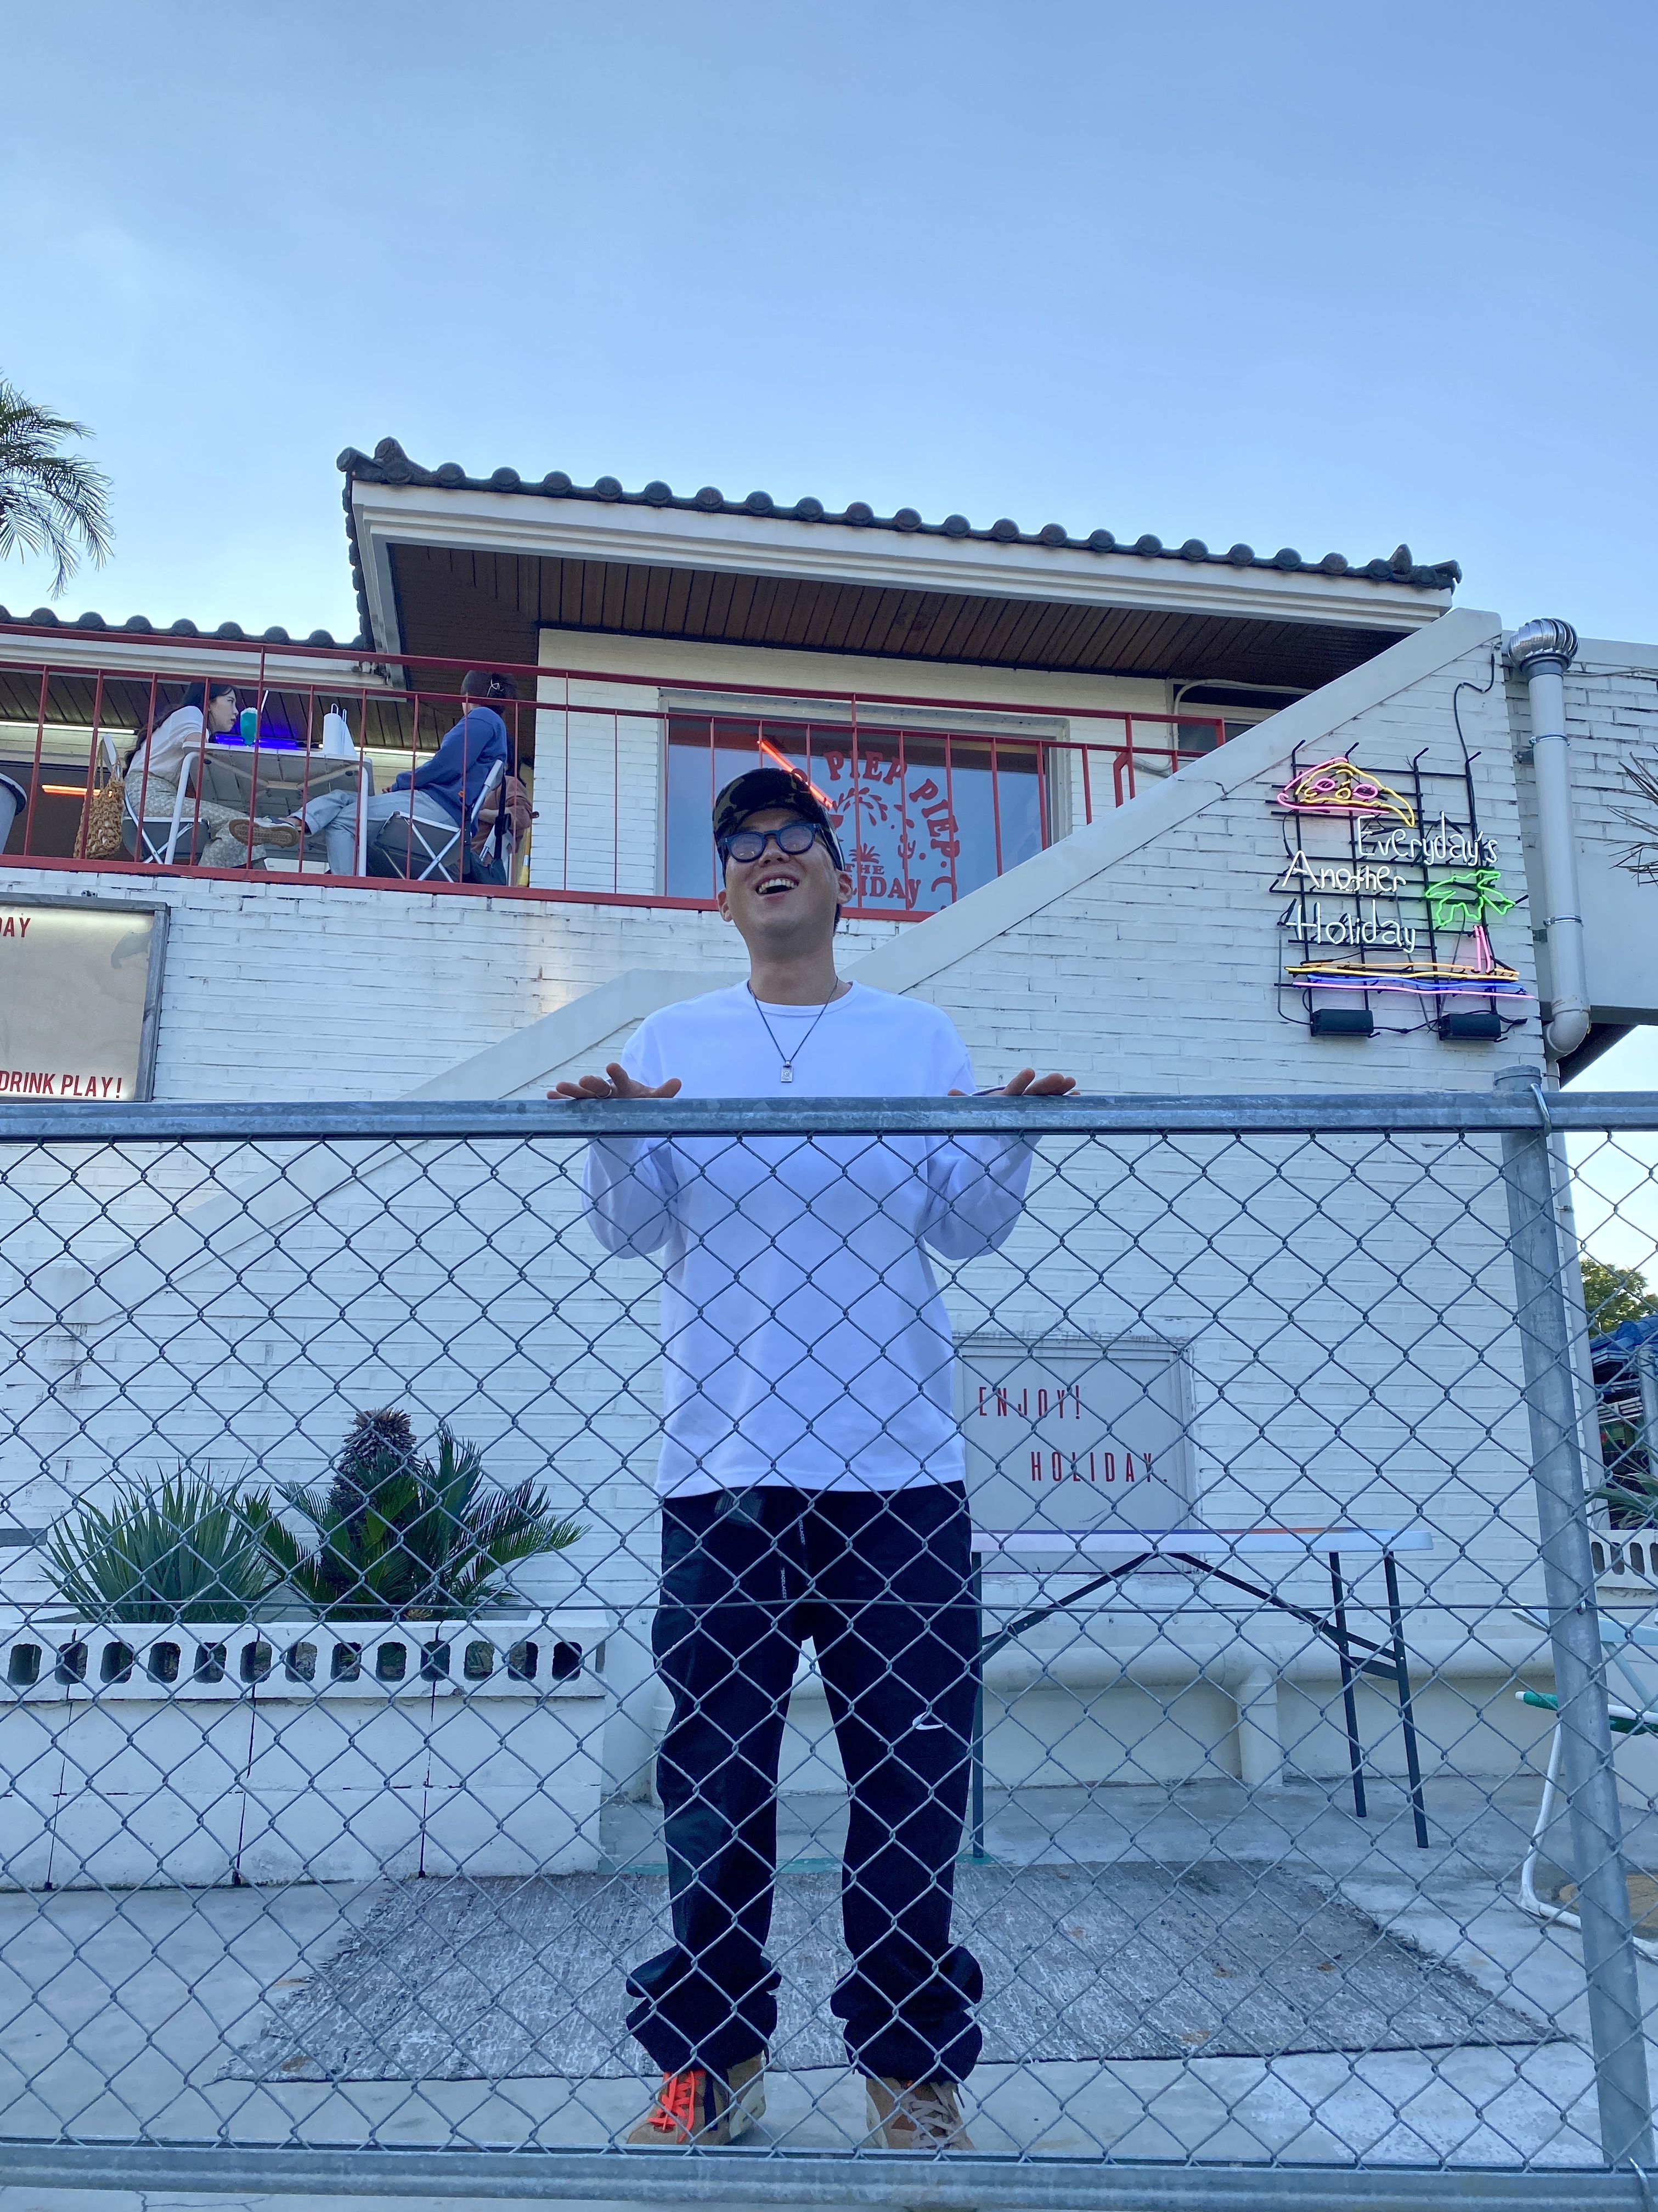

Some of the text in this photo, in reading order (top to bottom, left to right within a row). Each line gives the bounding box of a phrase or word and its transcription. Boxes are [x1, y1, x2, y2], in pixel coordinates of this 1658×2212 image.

[824, 751, 960, 858] PIEP PIEP
[1357, 811, 1498, 866] Everyday's
[845, 863, 885, 874] THE
[1282, 850, 1406, 892] Another
[1286, 899, 1417, 953] Holiday
[61, 1074, 122, 1098] PLAY!
[979, 1385, 1080, 1419] ENJOY!
[1030, 1452, 1168, 1482] HOLIDAY.
